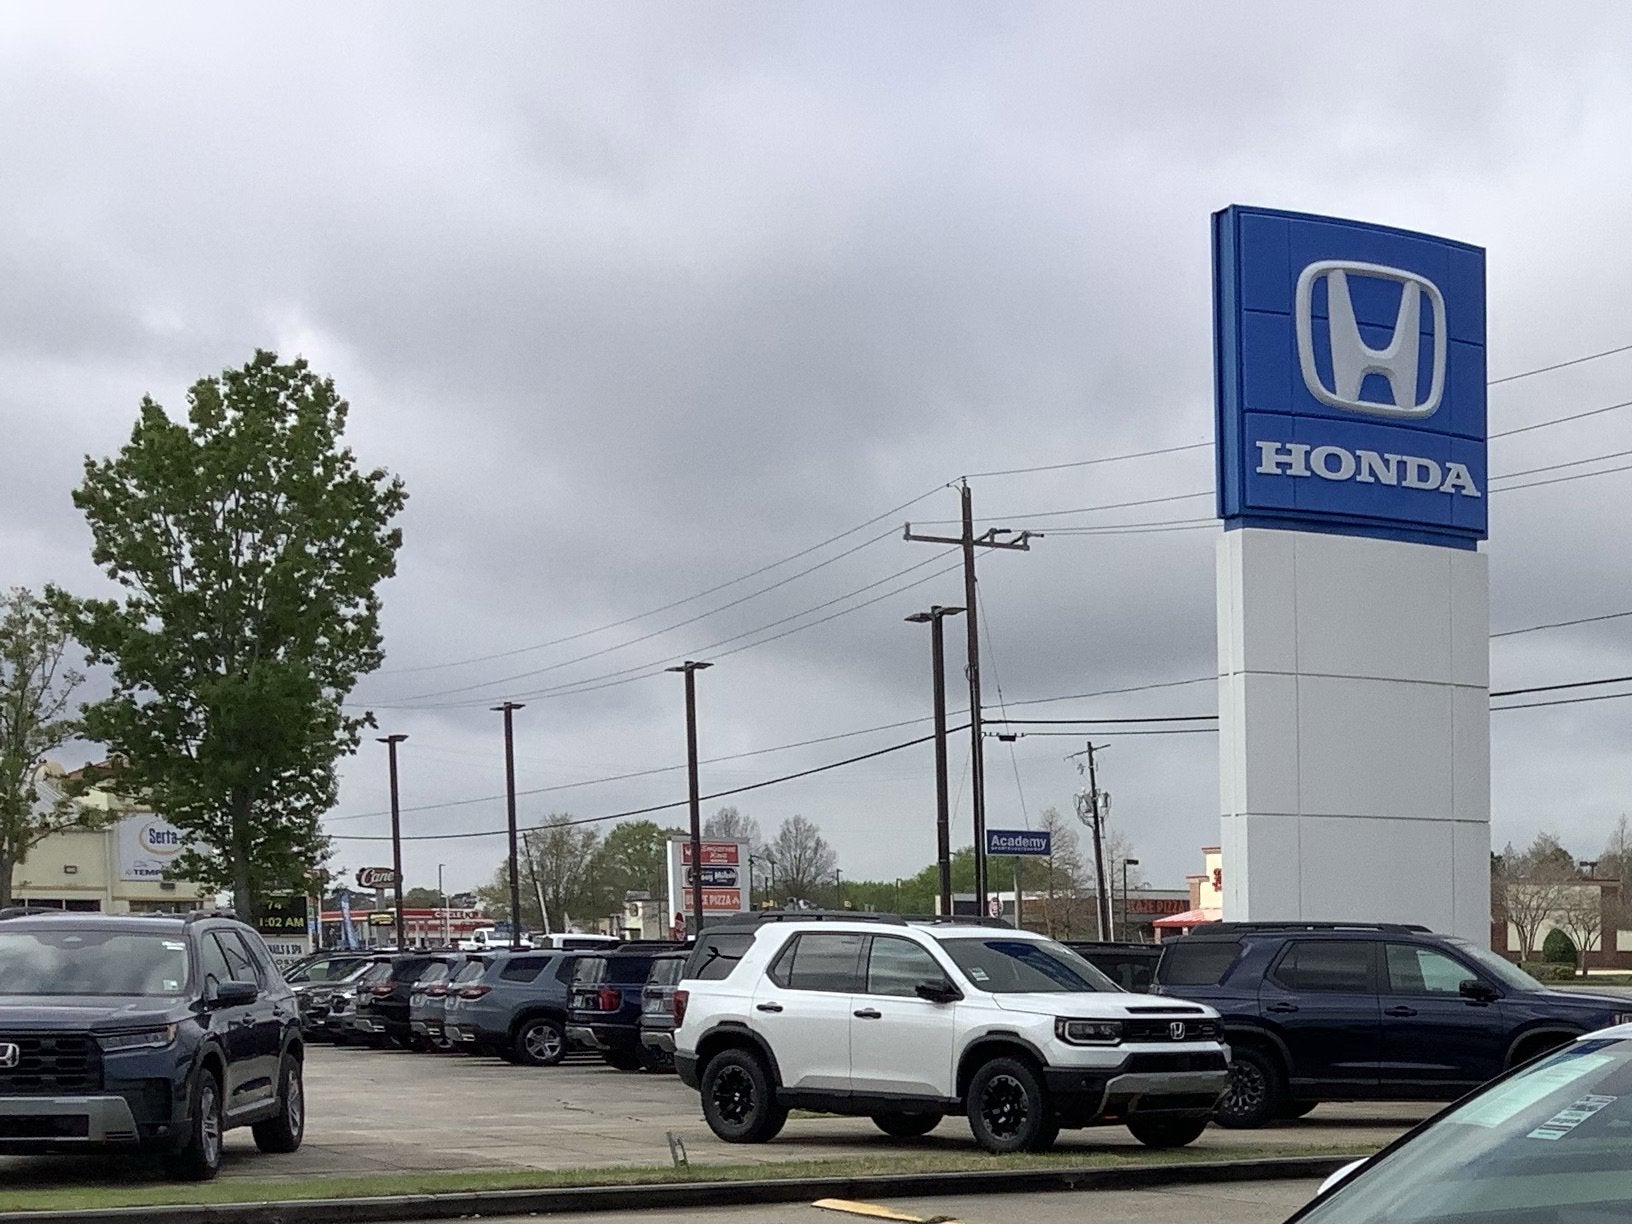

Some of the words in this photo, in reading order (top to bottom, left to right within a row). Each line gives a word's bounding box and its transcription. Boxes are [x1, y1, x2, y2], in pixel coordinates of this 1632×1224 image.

[1256, 440, 1481, 498] HONDA
[149, 827, 178, 845] Serta
[991, 834, 1047, 850] Academy
